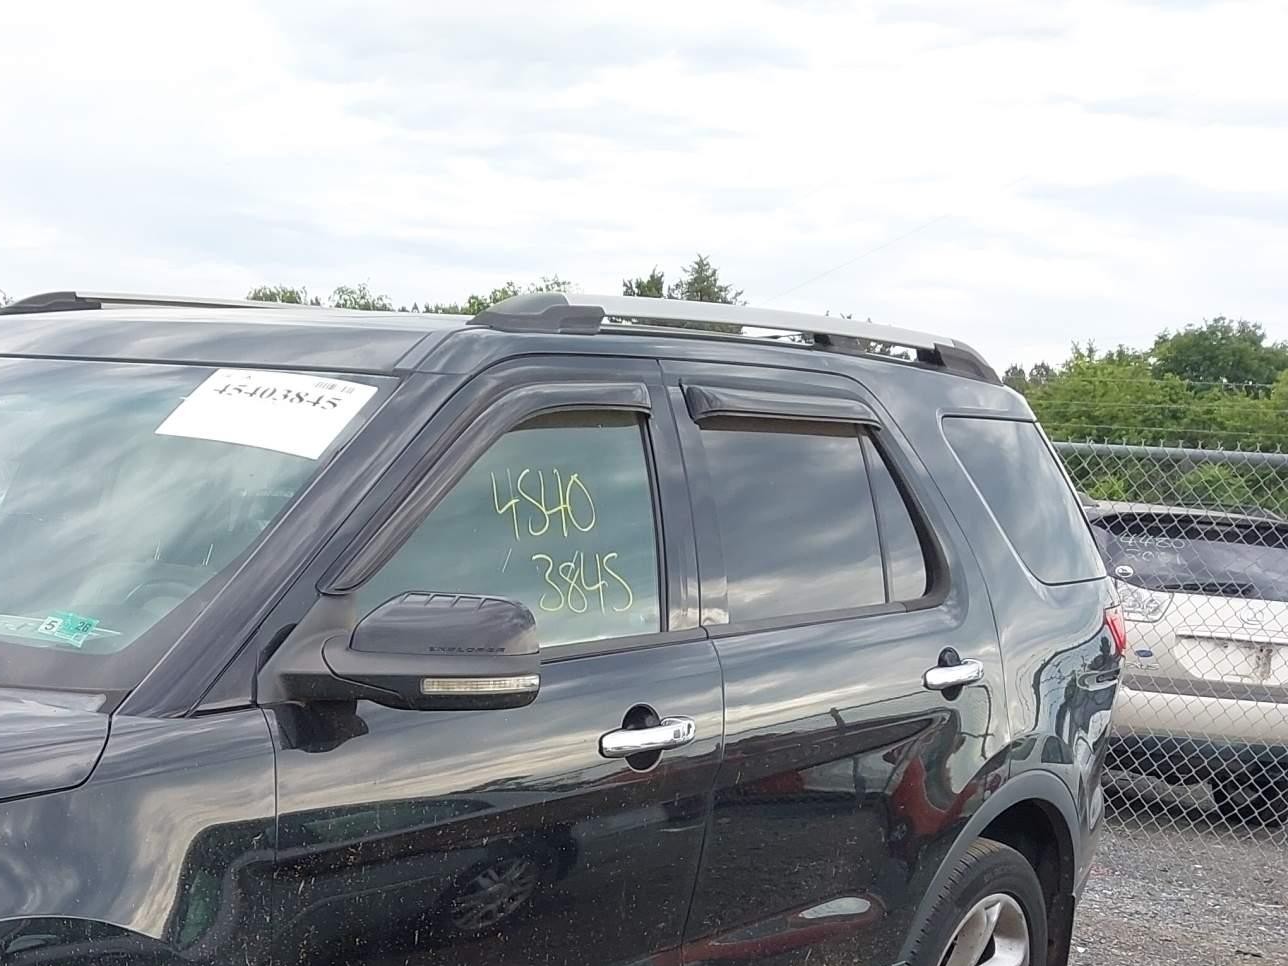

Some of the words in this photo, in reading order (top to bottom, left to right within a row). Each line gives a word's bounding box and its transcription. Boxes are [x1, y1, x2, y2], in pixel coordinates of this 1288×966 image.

[213, 383, 343, 410] 45403845
[531, 550, 634, 615] 3845
[44, 620, 57, 631] 5
